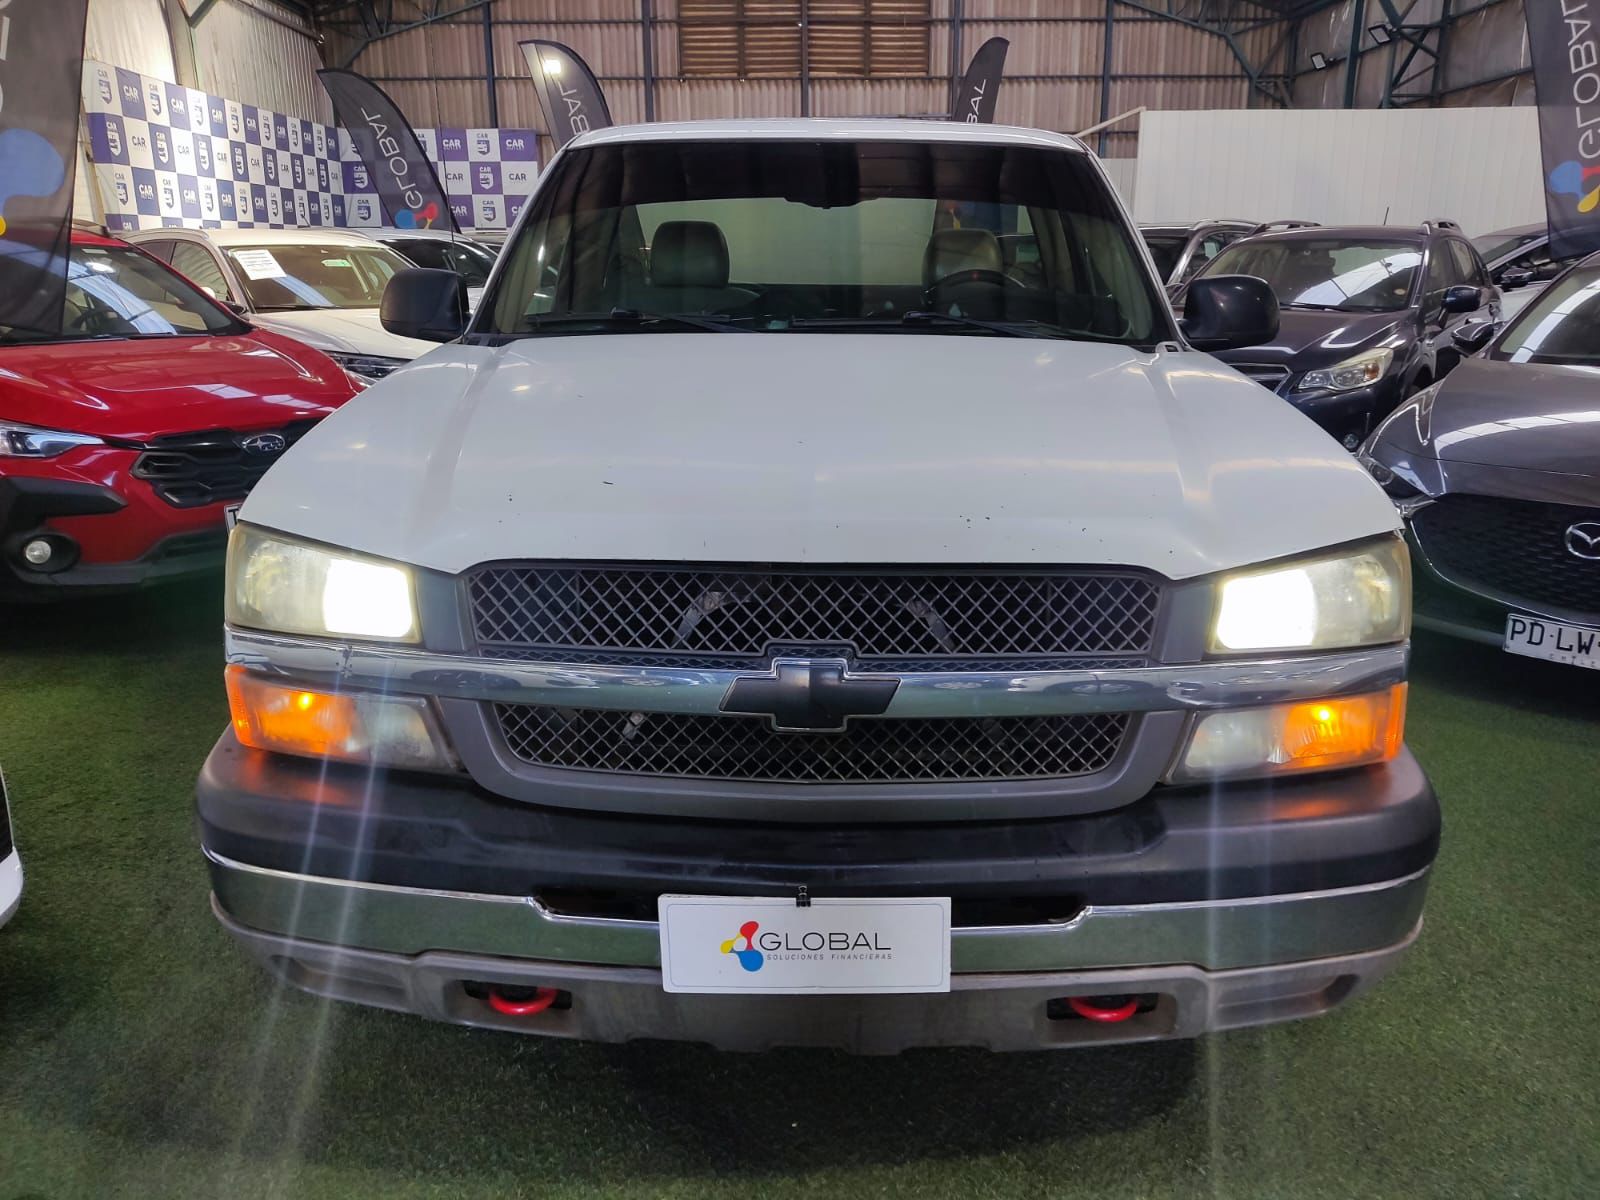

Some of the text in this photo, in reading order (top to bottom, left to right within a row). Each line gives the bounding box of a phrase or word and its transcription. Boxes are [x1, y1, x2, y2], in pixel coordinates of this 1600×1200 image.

[123, 85, 139, 99] CAR
[171, 98, 185, 112] CAR
[131, 136, 146, 147] CAR
[442, 139, 461, 149] CAR
[506, 139, 524, 149] CAR
[178, 145, 189, 155] CAR
[446, 173, 464, 181] CAR
[509, 173, 527, 181] CAR
[139, 184, 153, 197] CAR
[759, 932, 892, 951] GLOBAL
[766, 953, 892, 961] SOLUCIONES FINANCIERAS
